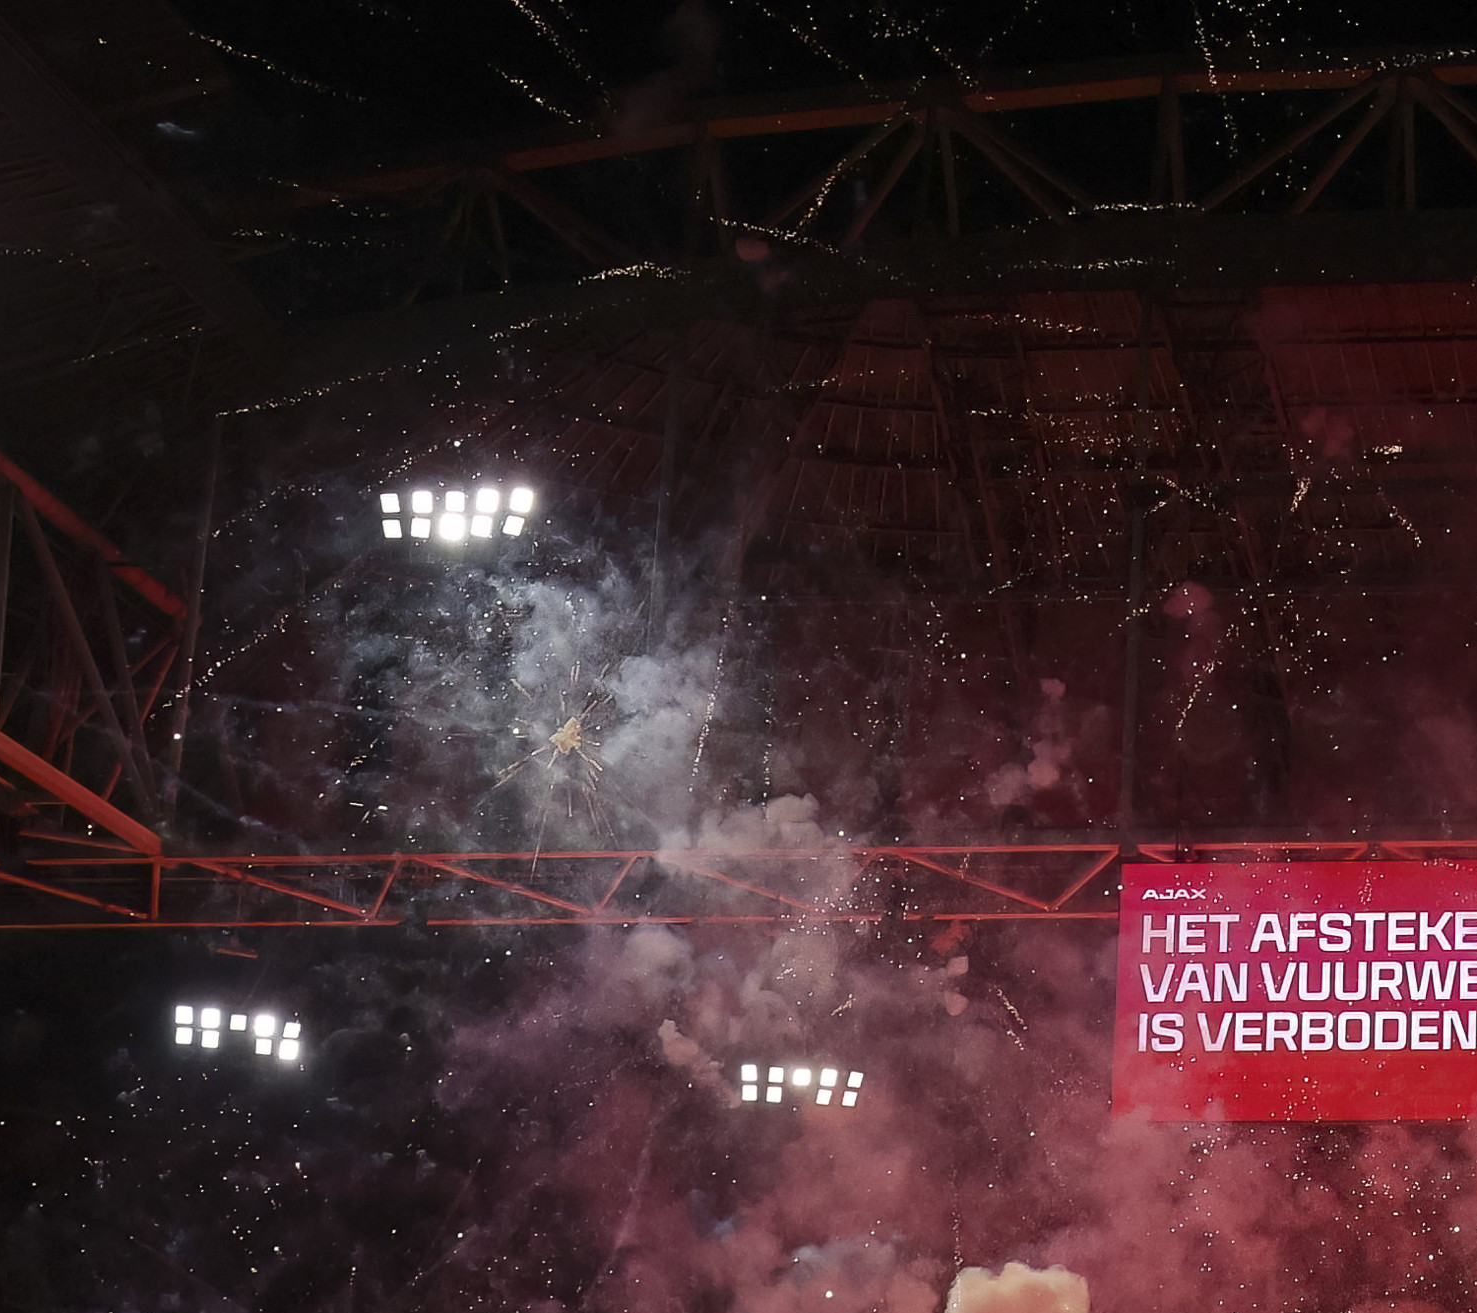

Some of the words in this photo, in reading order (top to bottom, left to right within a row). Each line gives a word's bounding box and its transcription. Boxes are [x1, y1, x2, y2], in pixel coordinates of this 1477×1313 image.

[1142, 889, 1207, 900] AJAX
[1141, 914, 1240, 954] HET
[1139, 962, 1248, 1003] VAN
[1137, 1012, 1185, 1053] IS
